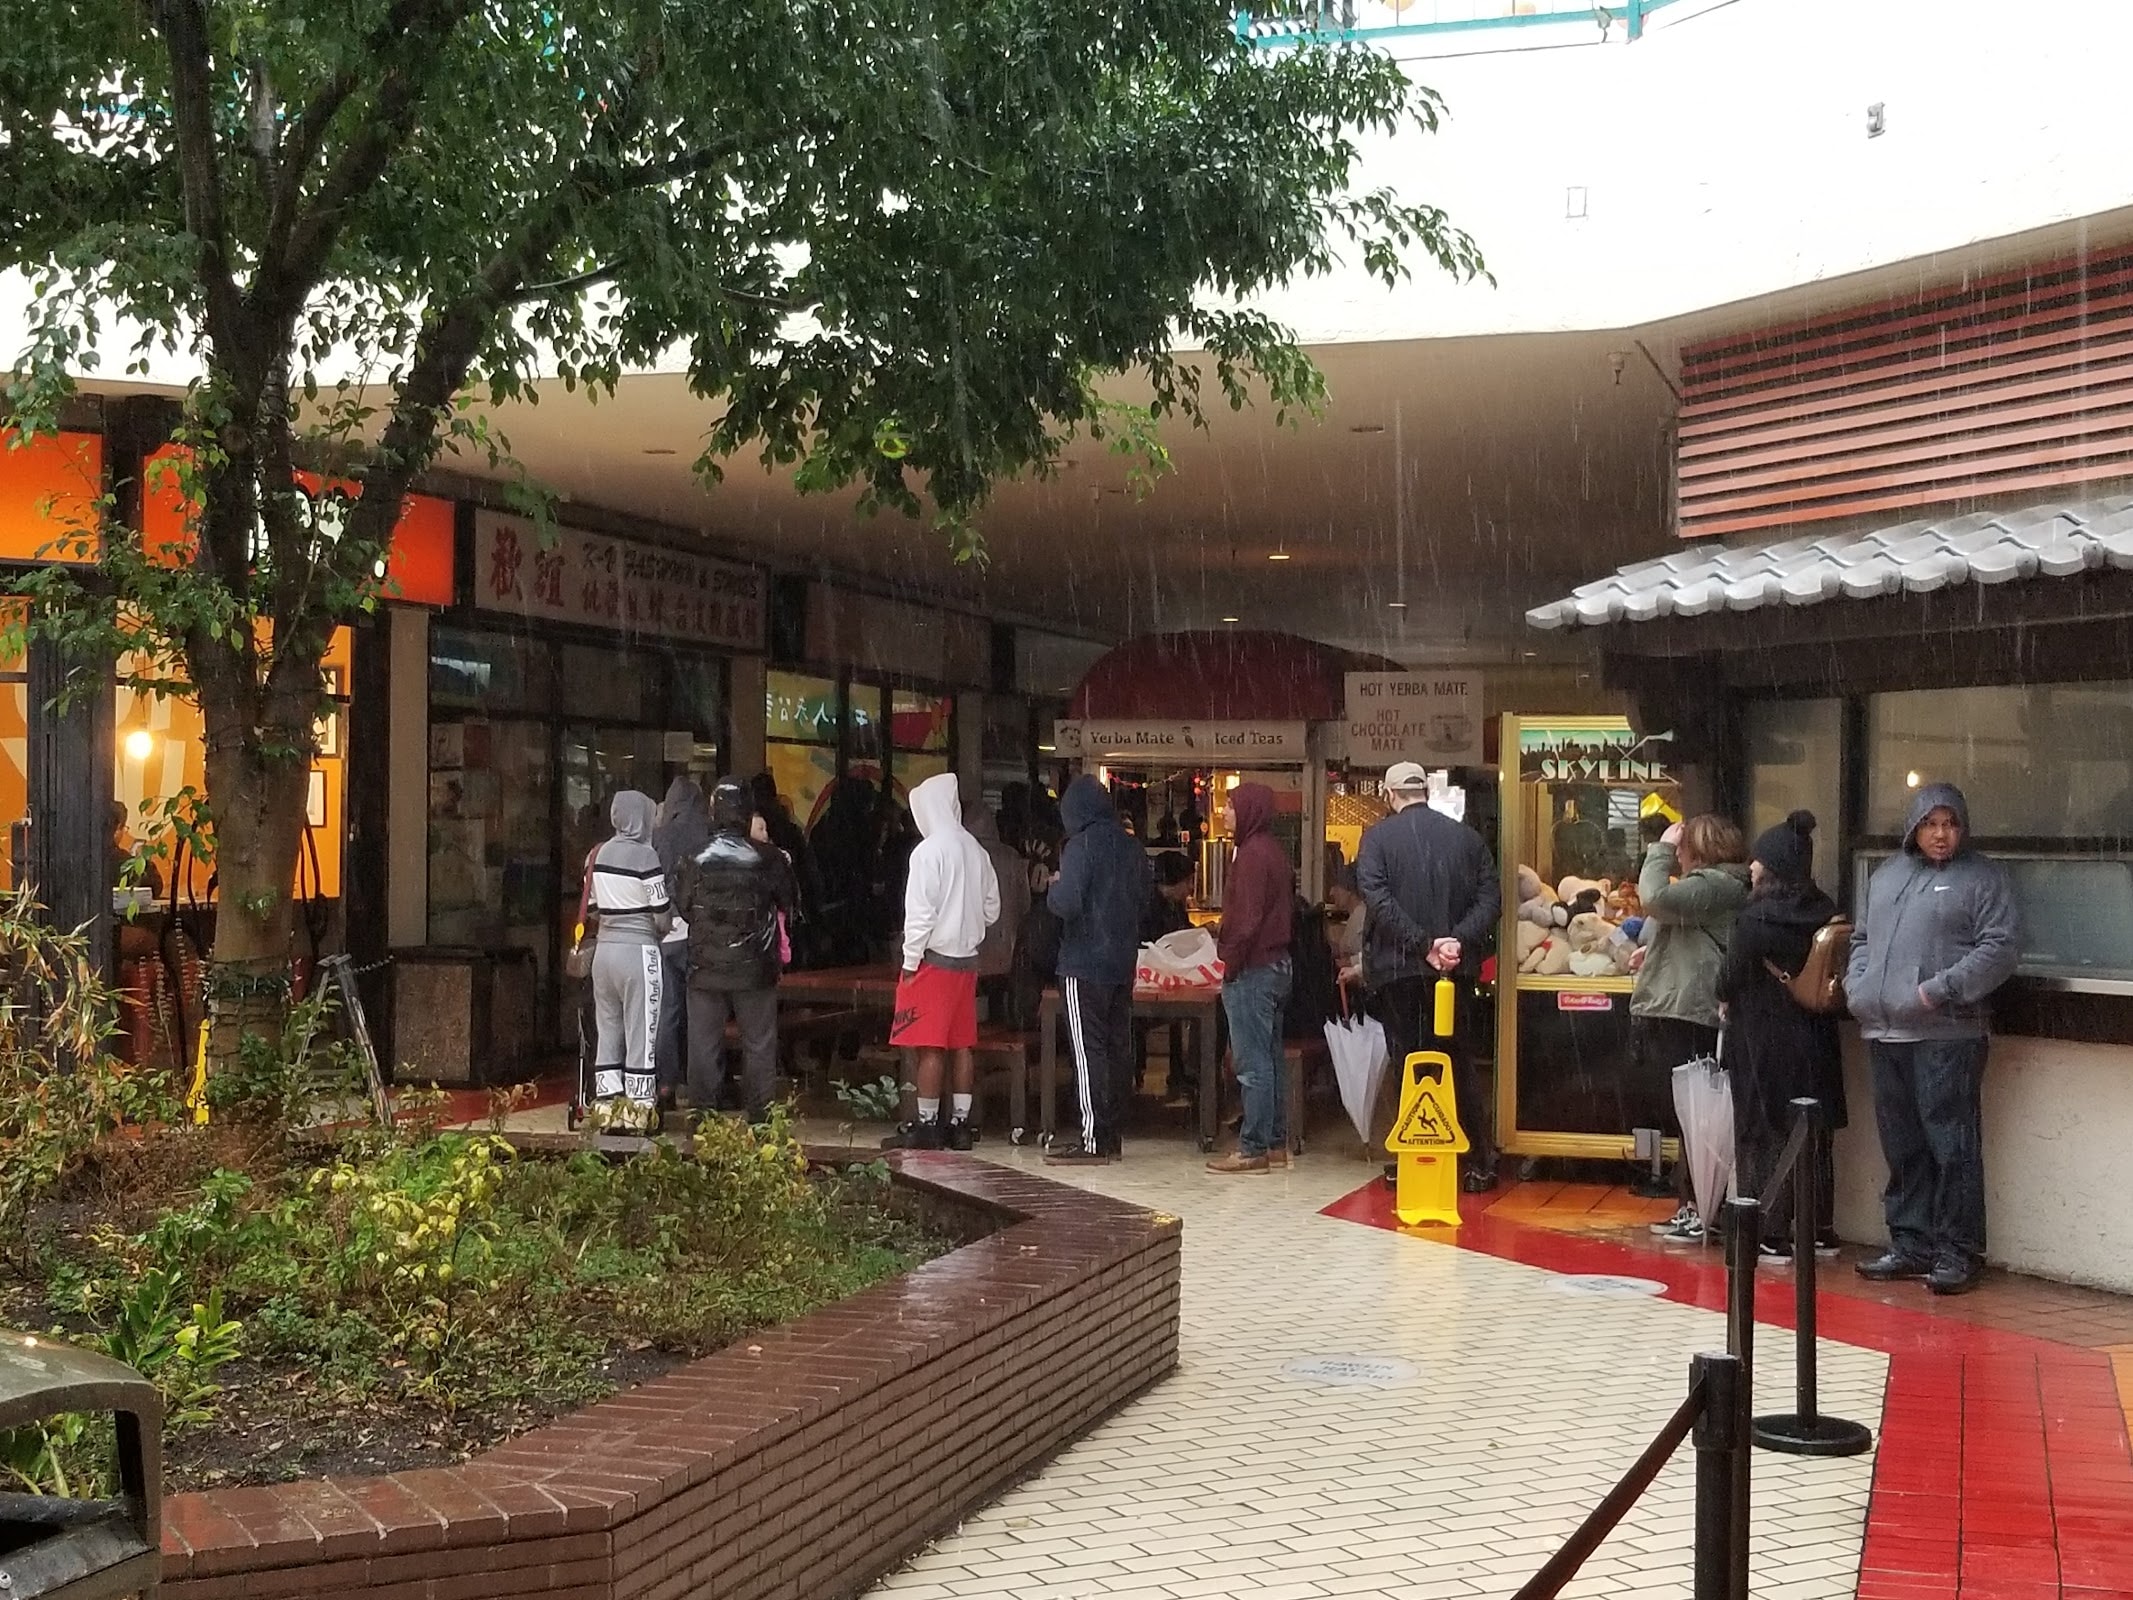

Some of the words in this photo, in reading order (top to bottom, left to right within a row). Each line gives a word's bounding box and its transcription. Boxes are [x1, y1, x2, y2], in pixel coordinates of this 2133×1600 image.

[1360, 682, 1383, 696] HOT
[1390, 682, 1428, 696] YERBA
[1434, 681, 1468, 696] MATE
[1376, 709, 1401, 722] HOT
[1351, 723, 1427, 737] CHOCOLATE
[1090, 731, 1132, 745] Yerba
[1136, 731, 1175, 745] Mate
[1215, 732, 1245, 745] Iced
[1250, 731, 1284, 745] Teas
[1371, 738, 1405, 751] MATE
[1541, 758, 1668, 779] SKYLINE
[1401, 1101, 1421, 1131] CAUTION
[1432, 1102, 1452, 1131] CUIDADO
[1407, 1138, 1446, 1146] ATTENTION
